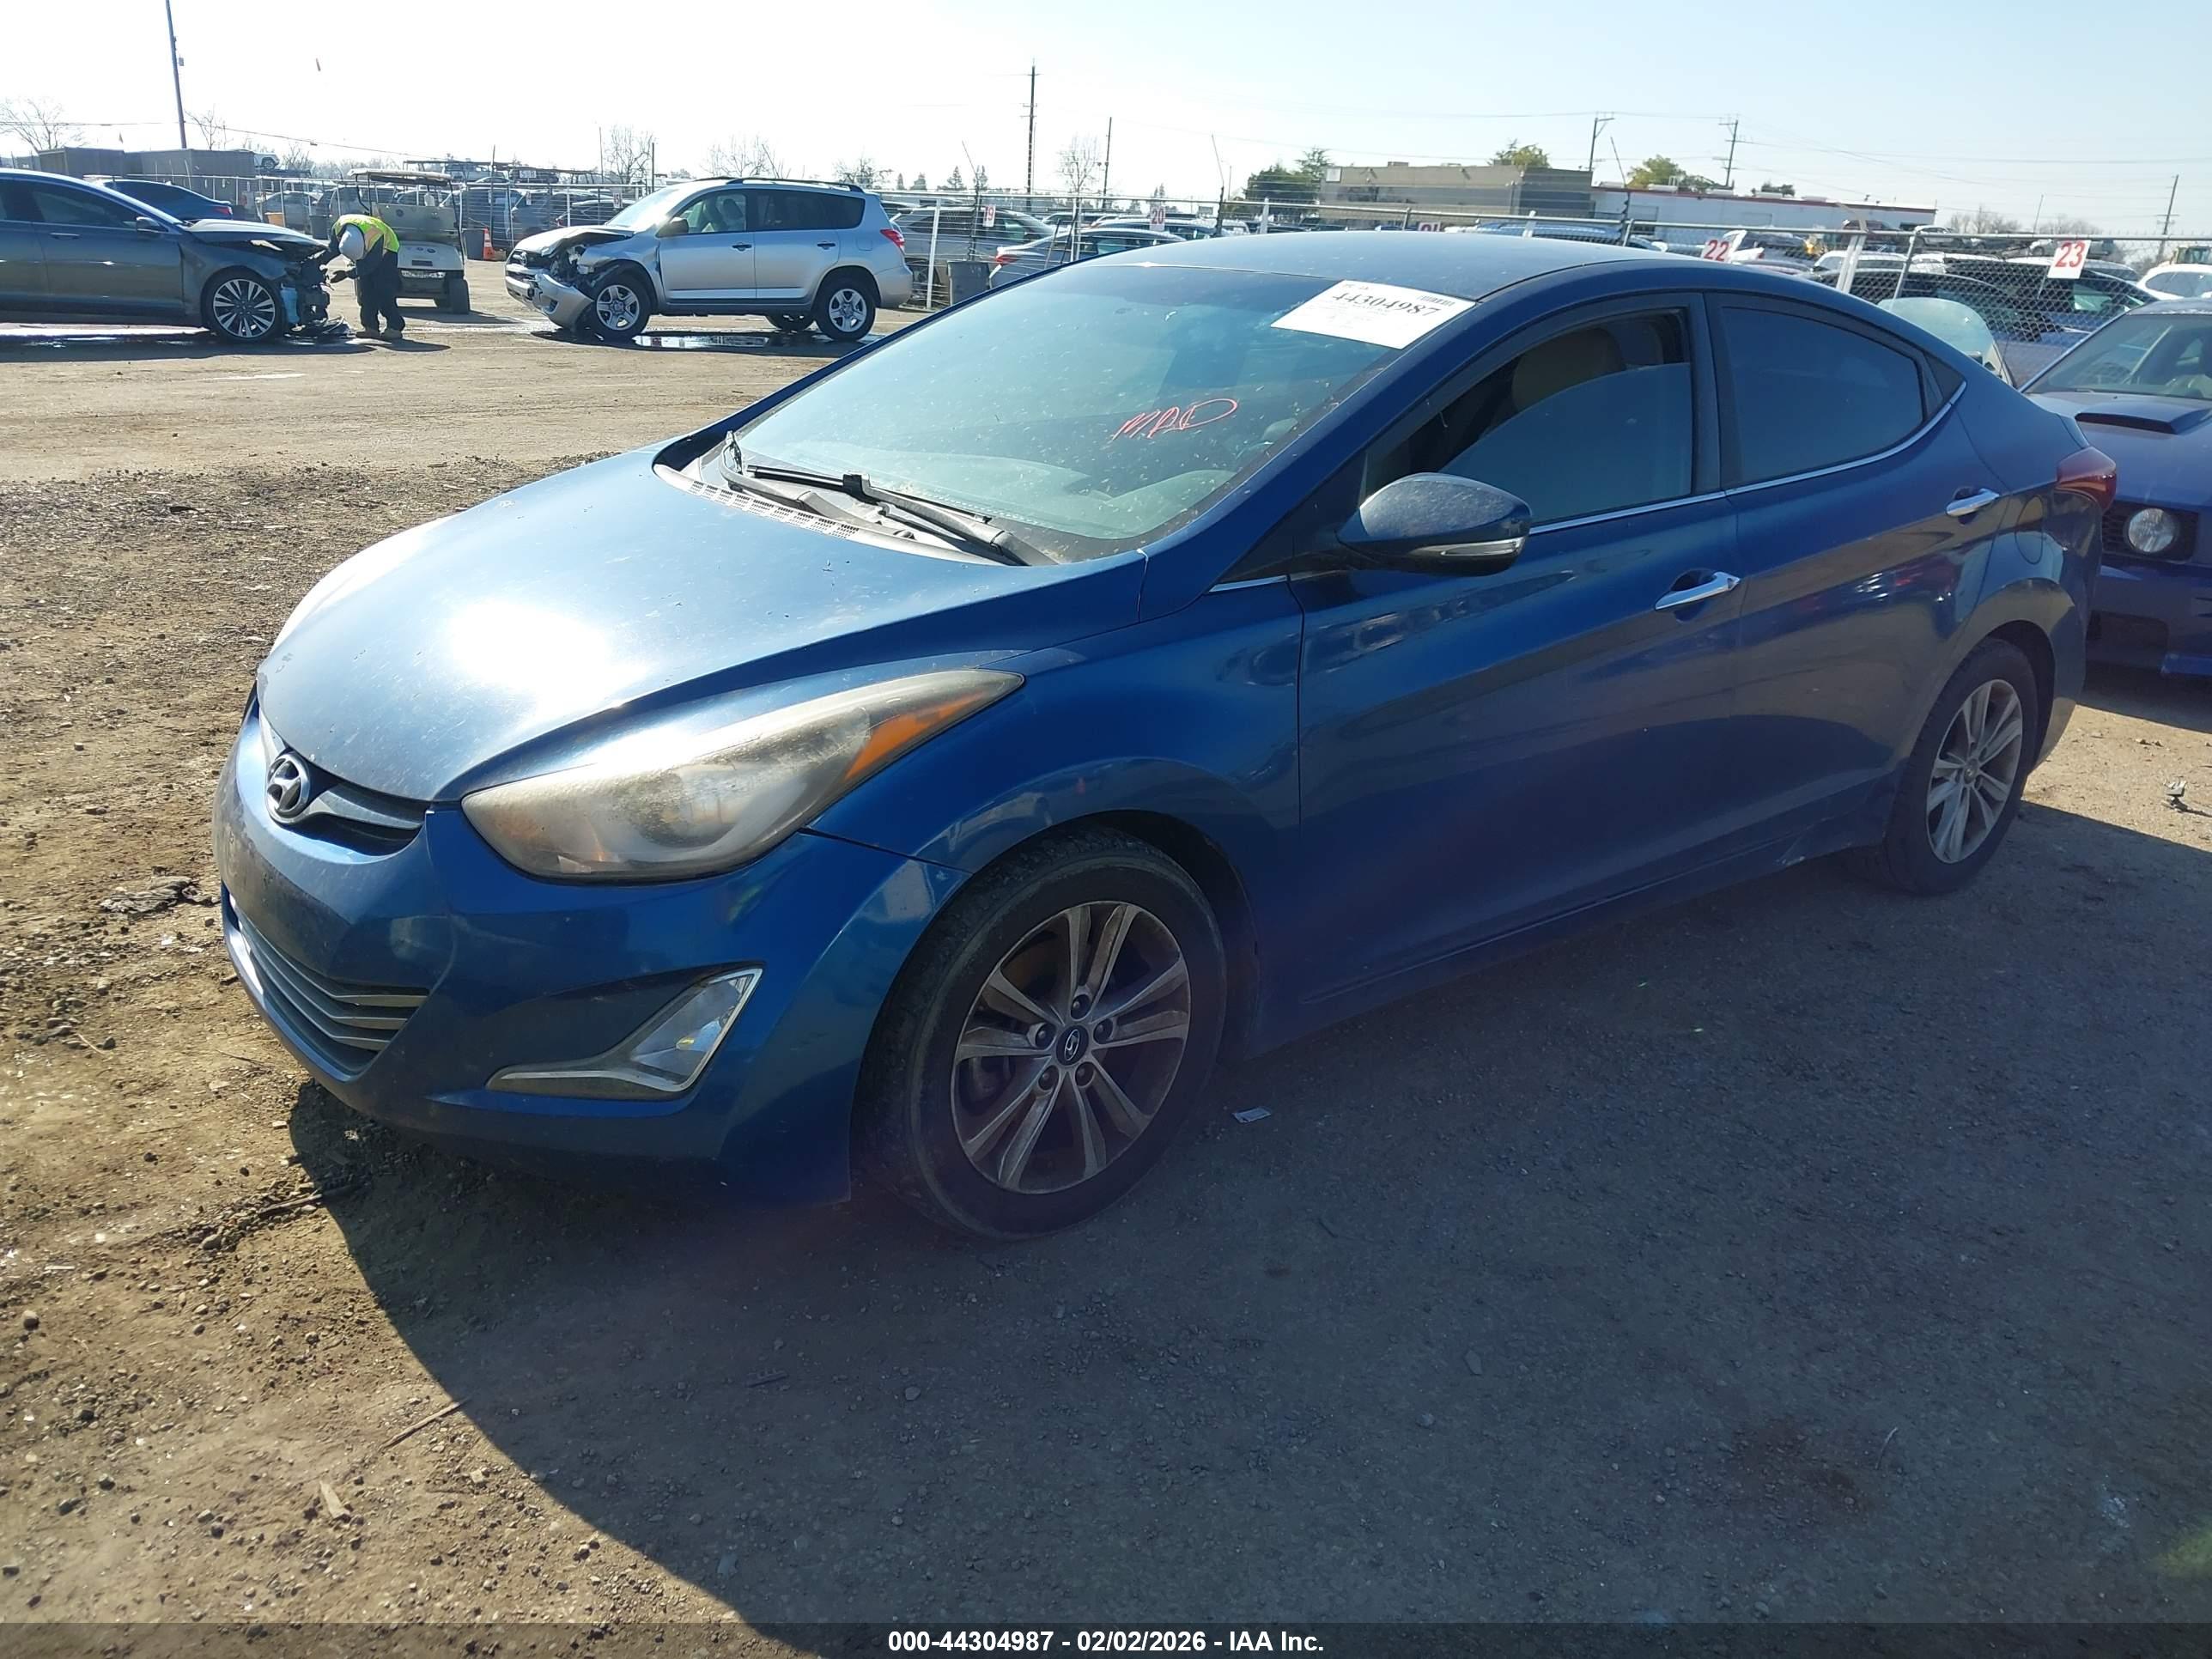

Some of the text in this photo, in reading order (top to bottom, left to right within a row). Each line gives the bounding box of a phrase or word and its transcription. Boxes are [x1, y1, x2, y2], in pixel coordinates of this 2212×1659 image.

[1151, 208, 1164, 224] 20
[1703, 240, 1729, 261] 22
[2054, 241, 2086, 268] 23
[1332, 292, 1442, 317] 44304987
